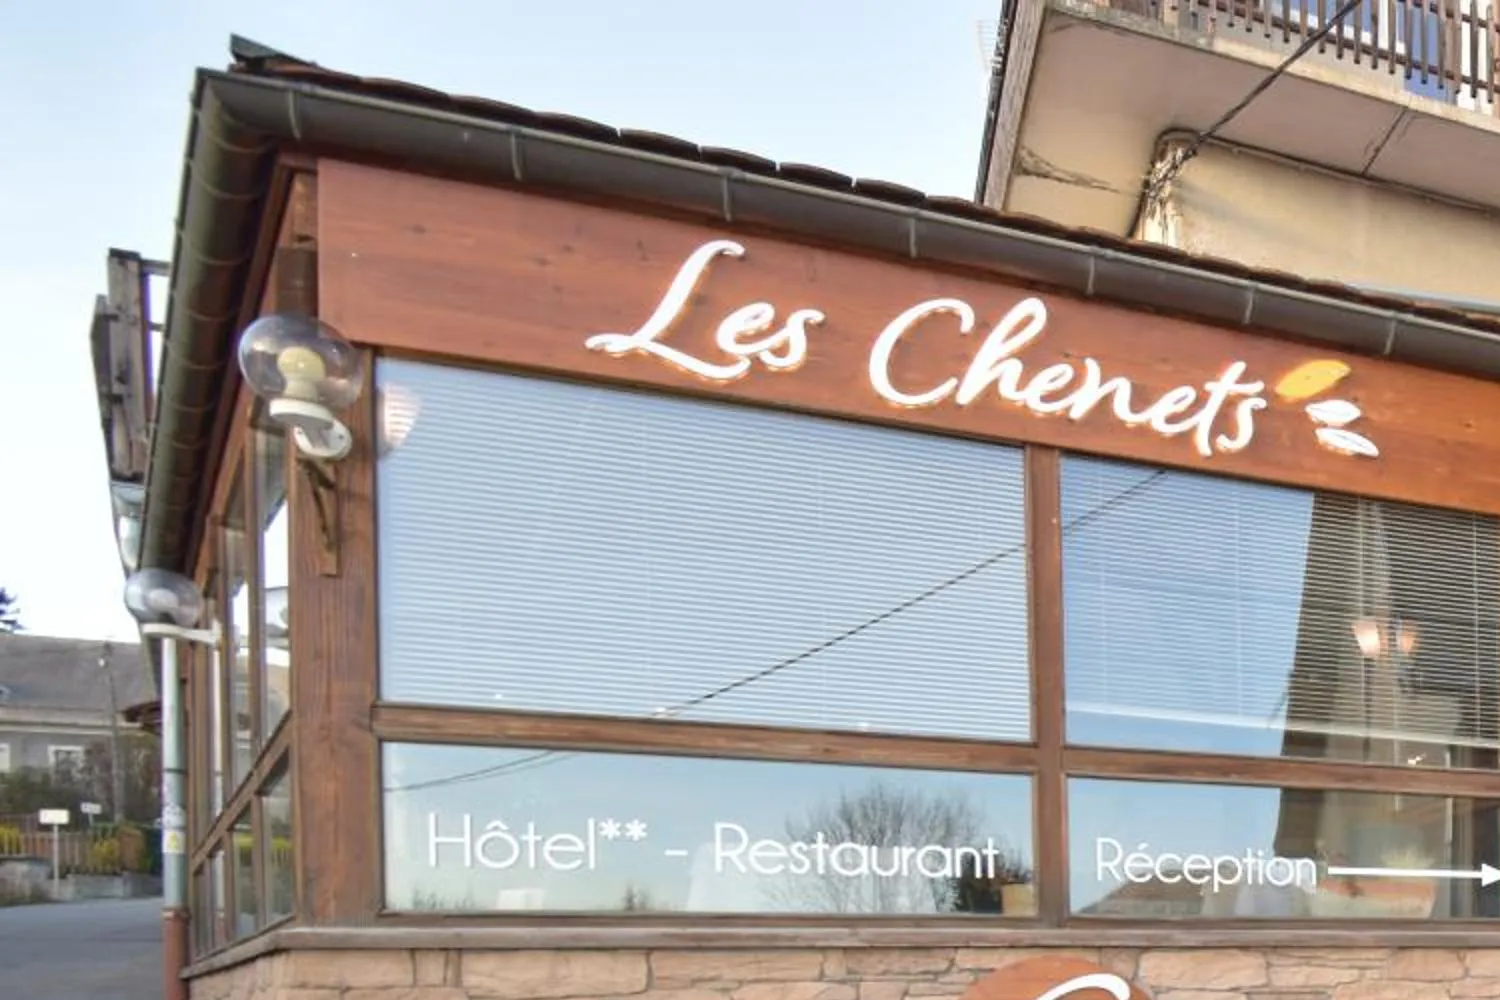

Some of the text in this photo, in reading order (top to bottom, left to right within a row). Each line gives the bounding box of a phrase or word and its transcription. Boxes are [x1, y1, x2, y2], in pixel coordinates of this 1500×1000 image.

[584, 239, 1267, 456] Les Chenets
[713, 822, 999, 879] Restaurant
[1095, 837, 1318, 893] Réception
